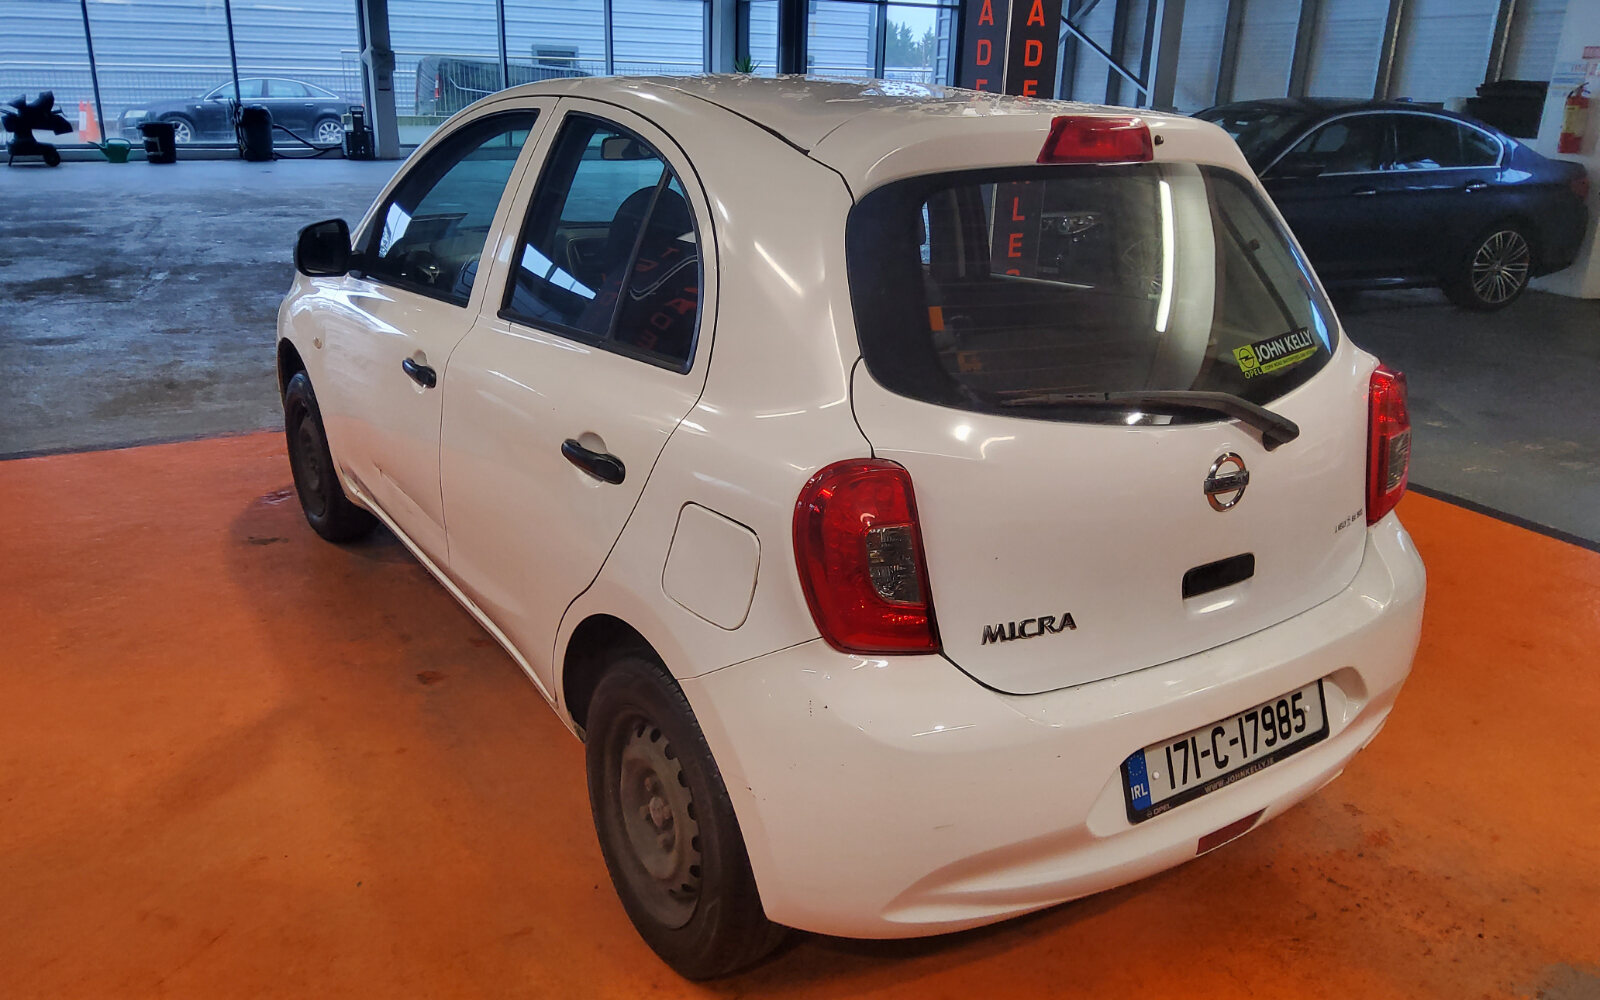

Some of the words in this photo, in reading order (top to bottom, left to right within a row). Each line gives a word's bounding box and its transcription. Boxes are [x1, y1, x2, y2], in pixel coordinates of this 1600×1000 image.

[1255, 338, 1287, 362] JOHN
[1284, 330, 1313, 352] KELLY
[1244, 367, 1263, 379] OPEL
[981, 612, 1077, 645] MICRA
[1165, 692, 1306, 789] 171-C-17985
[1131, 782, 1148, 800] IRL
[1153, 803, 1171, 815] OPEL
